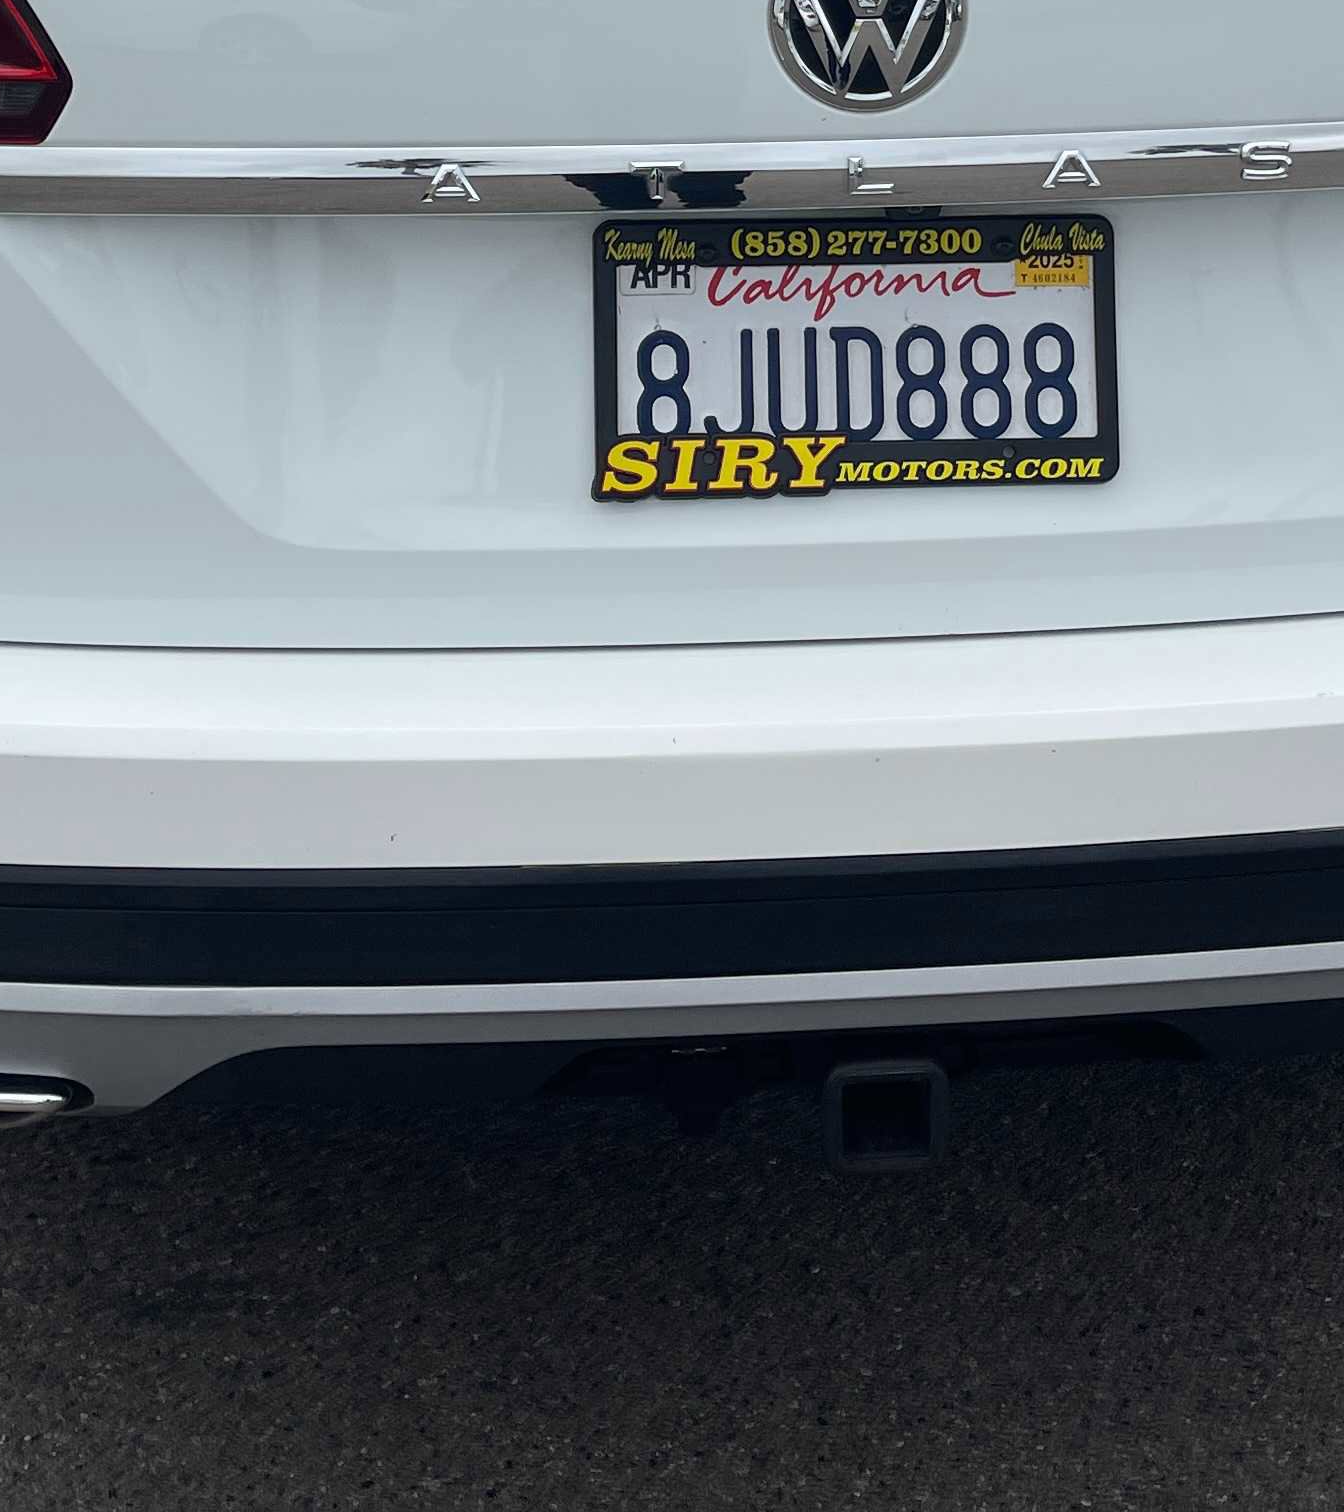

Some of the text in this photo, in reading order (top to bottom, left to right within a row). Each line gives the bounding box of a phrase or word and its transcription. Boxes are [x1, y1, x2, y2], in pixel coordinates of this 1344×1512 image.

[421, 140, 1293, 204] ATLAS
[605, 222, 1105, 266] Kearny Mesa (858) 277-7300 Chula Vista
[1028, 254, 1074, 269] 2025
[630, 265, 691, 289] APR
[707, 265, 1016, 321] California
[636, 322, 1078, 441] 8JUD888
[602, 435, 1105, 493] SIRY MOTORS.COM
